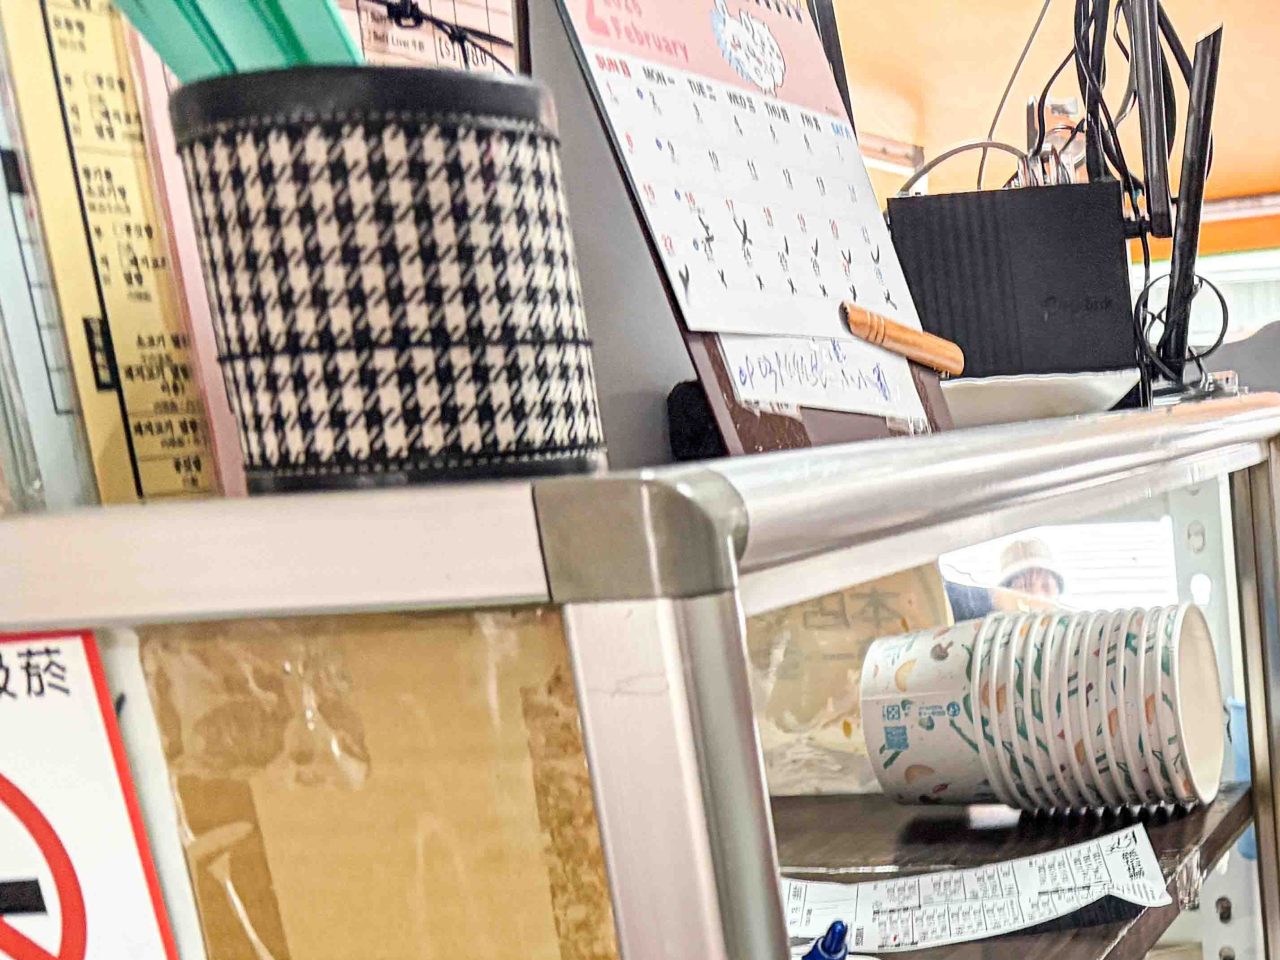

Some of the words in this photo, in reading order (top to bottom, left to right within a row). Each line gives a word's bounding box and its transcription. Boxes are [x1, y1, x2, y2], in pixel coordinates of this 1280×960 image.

[610, 15, 690, 63] February
[595, 54, 620, 75] SUN
[642, 66, 668, 87] MON
[687, 79, 708, 99] TUE
[726, 90, 747, 111] WED
[764, 102, 782, 120] THU
